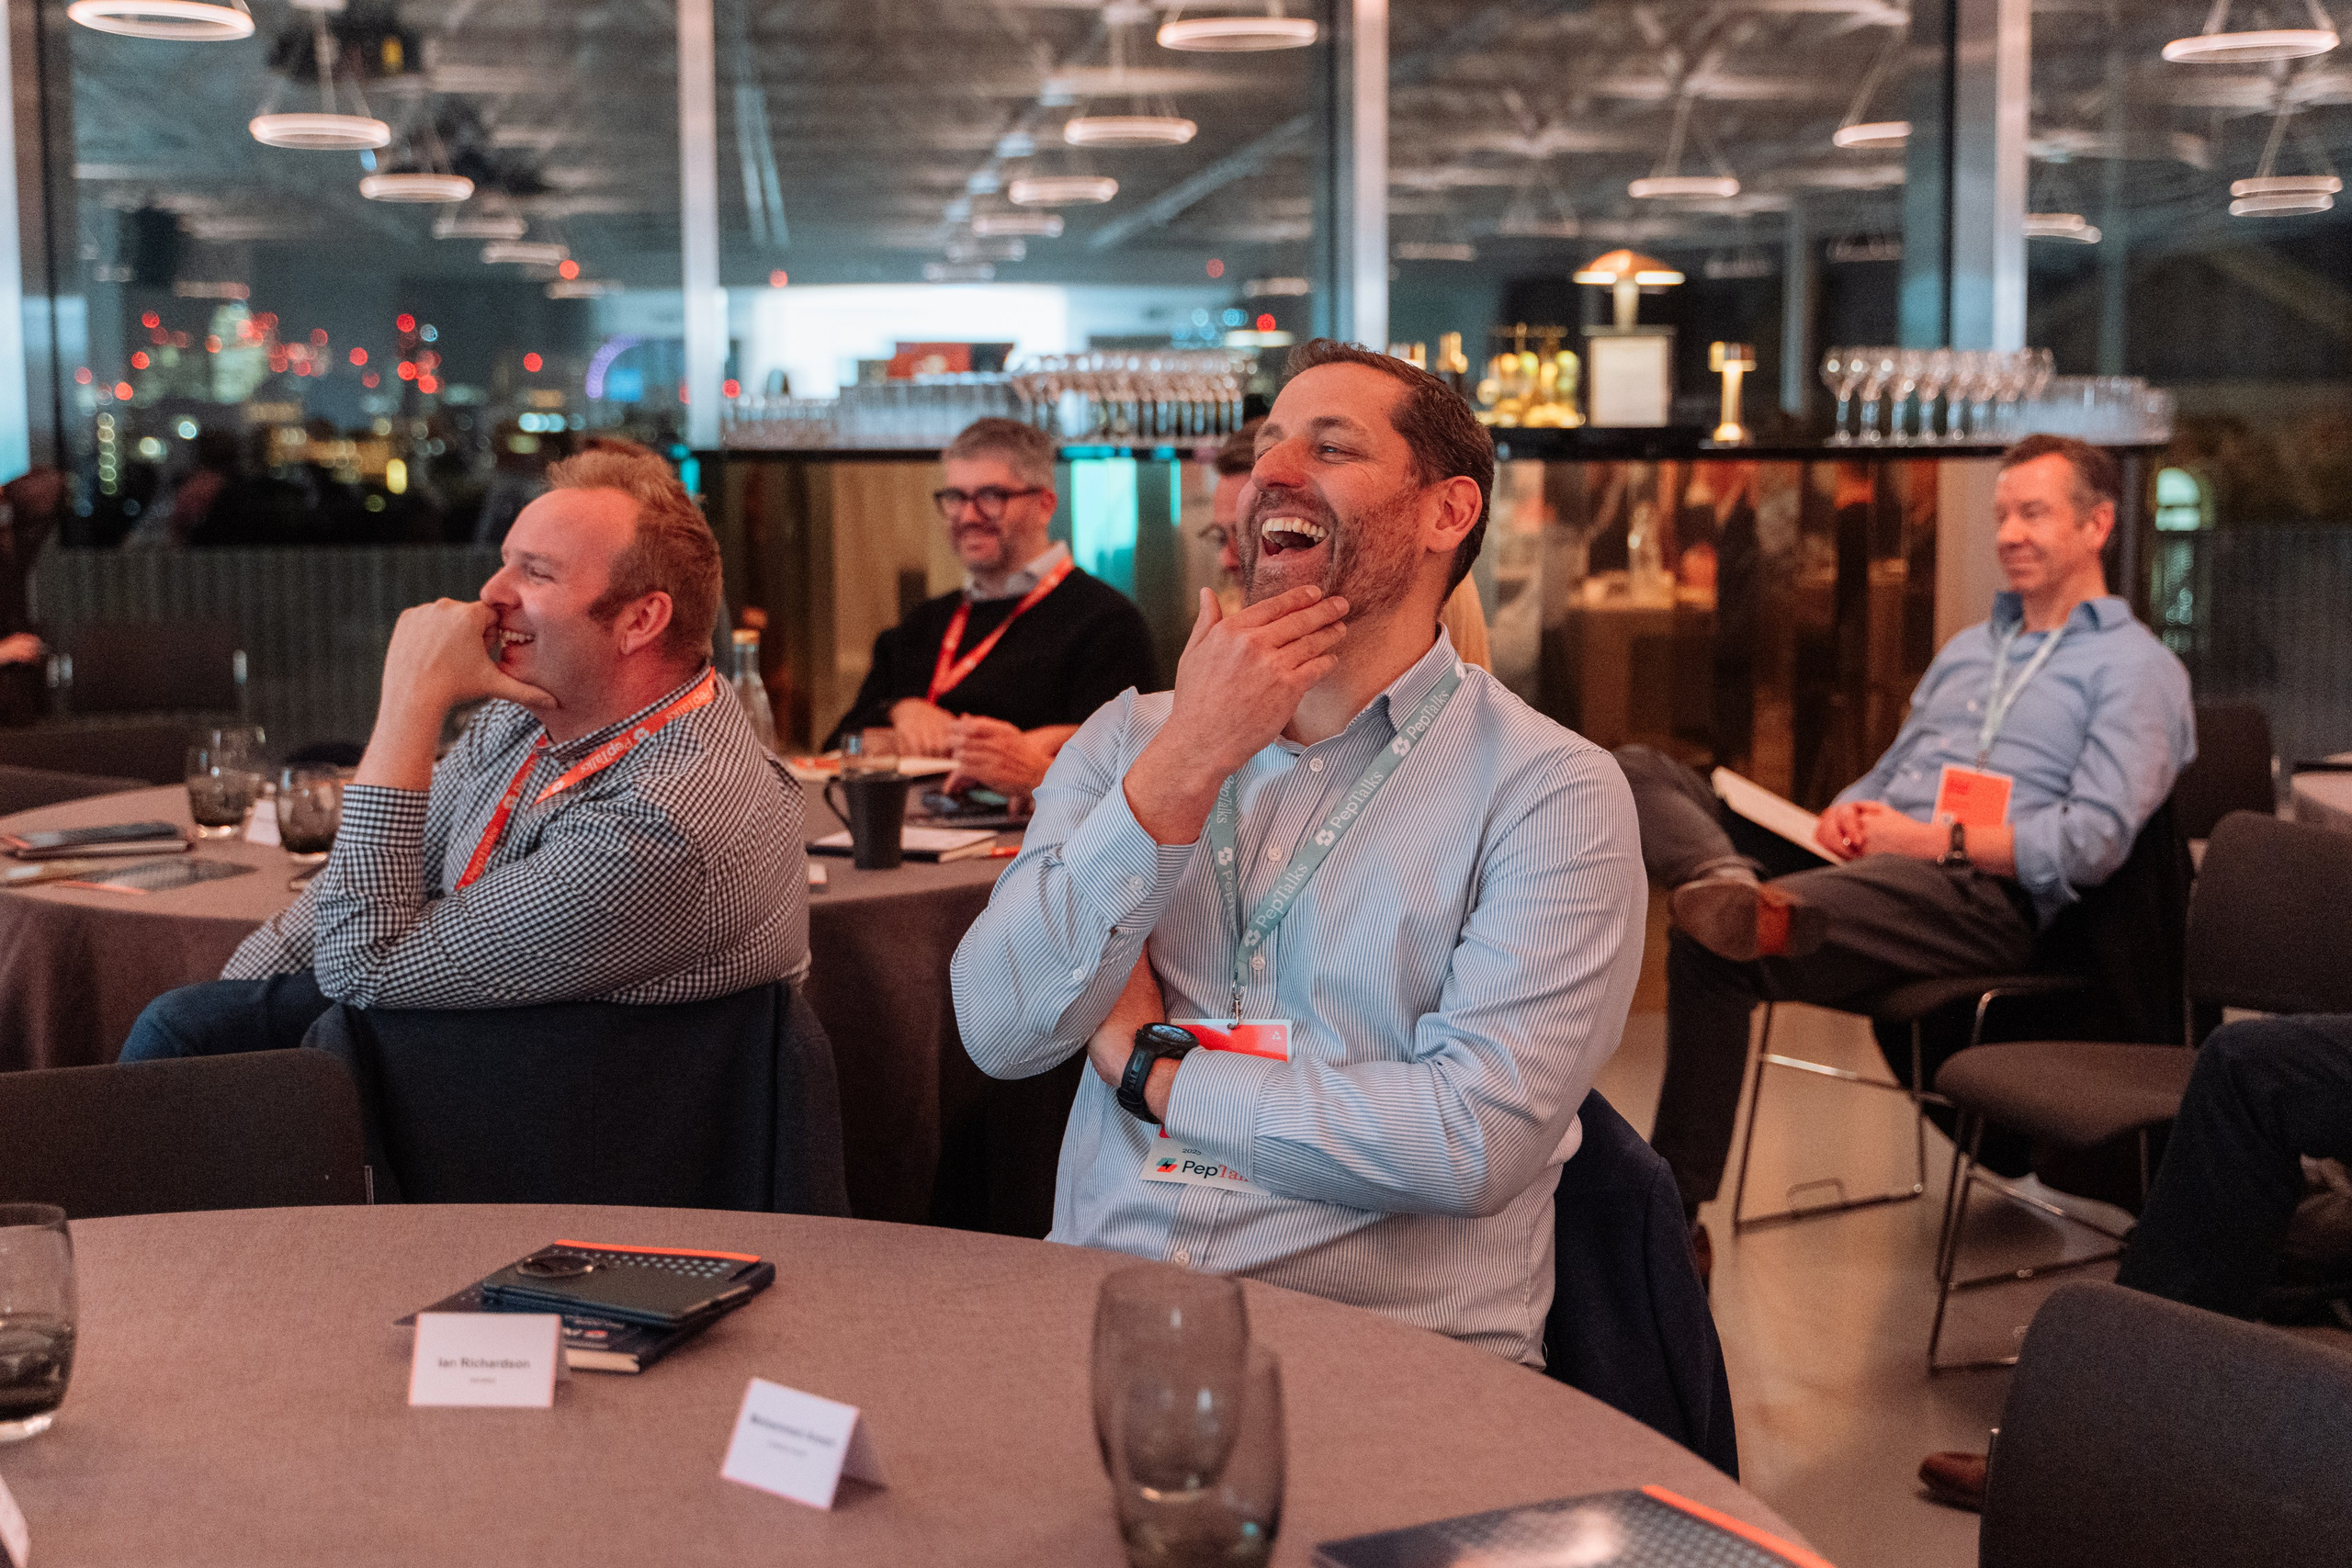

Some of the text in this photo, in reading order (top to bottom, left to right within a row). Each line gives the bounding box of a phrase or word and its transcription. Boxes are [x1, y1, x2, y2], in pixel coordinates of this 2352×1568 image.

[1407, 689, 1451, 741] PepTalks
[580, 738, 634, 773] PepTalks
[1330, 770, 1385, 829] PepTalks
[1255, 863, 1309, 930] PepTalks
[1182, 1147, 1202, 1156] 2025
[438, 1356, 531, 1369] Ian Richardson
